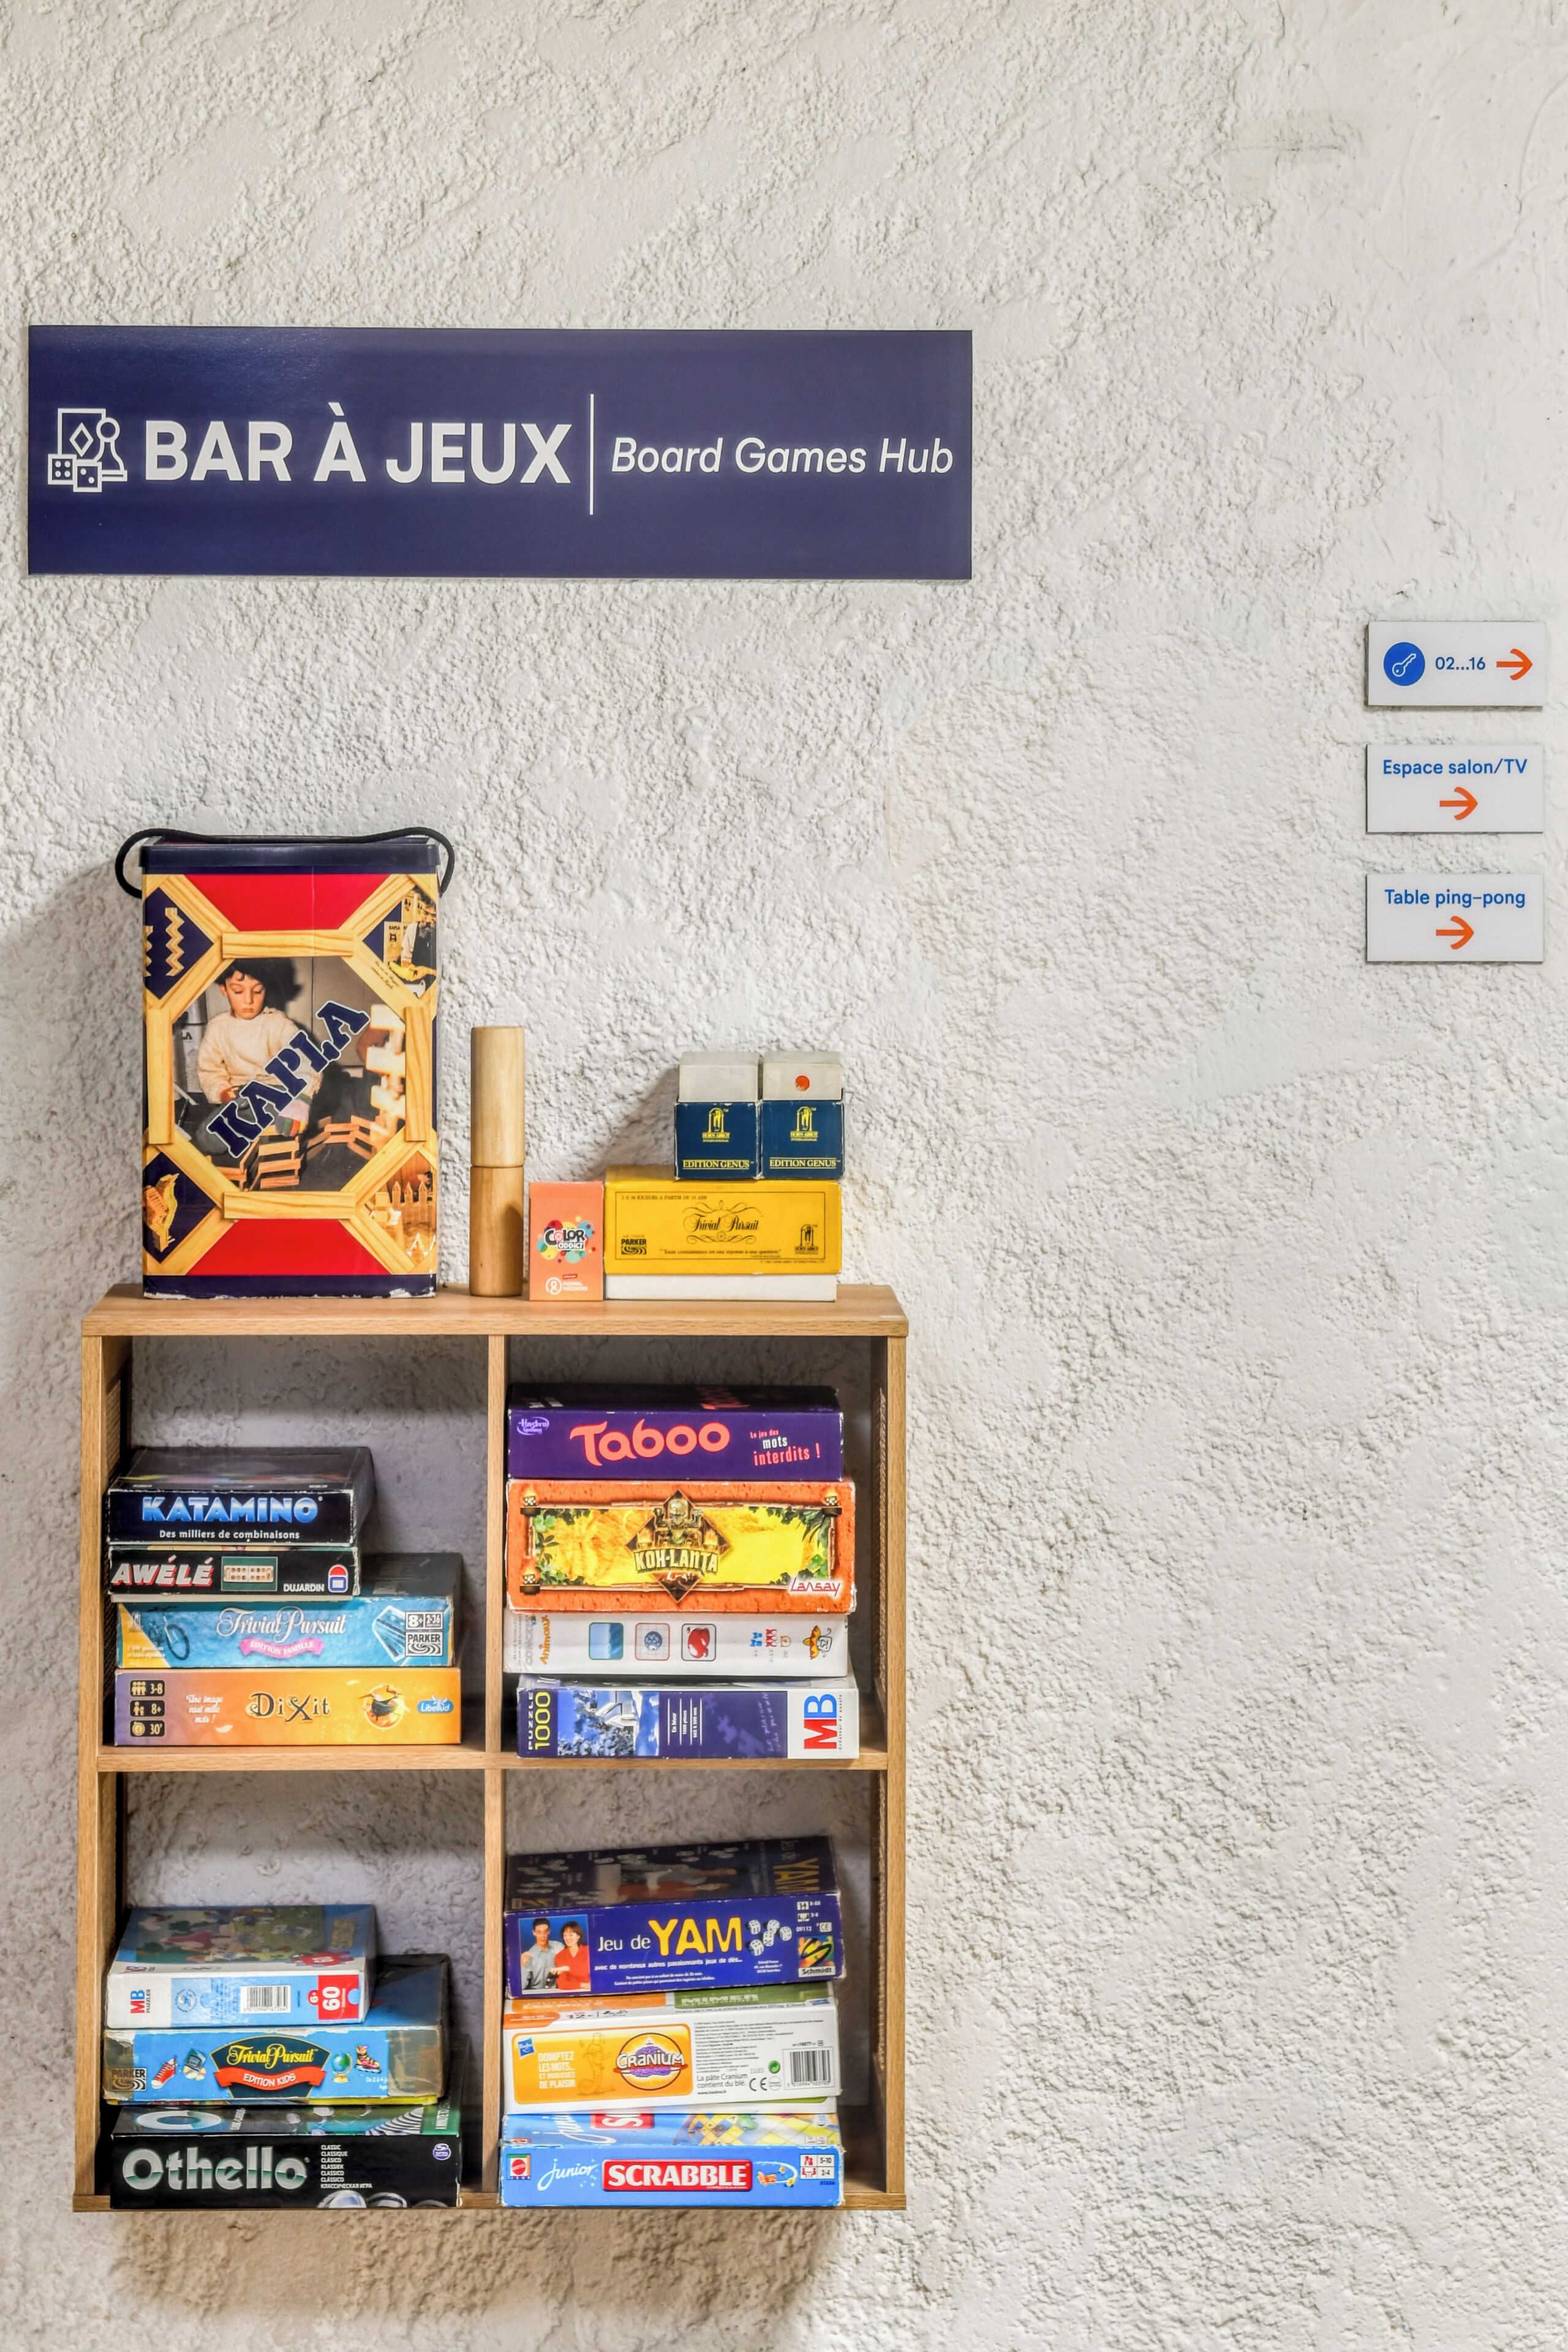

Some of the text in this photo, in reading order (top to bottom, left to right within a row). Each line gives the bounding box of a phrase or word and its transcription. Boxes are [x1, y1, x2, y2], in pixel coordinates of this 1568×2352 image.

[145, 401, 572, 484] BAR À JEUX
[611, 437, 954, 475] Board Games Hub
[1434, 656, 1487, 671] 02...16
[1382, 758, 1528, 780] Espace salon/TV
[1384, 889, 1526, 908] Table ping-pong
[205, 1000, 371, 1158] KAPLA
[690, 1213, 760, 1233] Trivial Pursuit
[569, 1418, 731, 1466] Taboo
[758, 1430, 767, 1439] jeu
[763, 1436, 788, 1450] mots
[753, 1446, 810, 1466] interdits
[142, 1496, 318, 1523] KATAMINO
[159, 1529, 300, 1540] Des milliers de combinaisons
[635, 1549, 718, 1573] KOH-LANTA
[110, 1555, 214, 1587] AWÉLÉ
[283, 1583, 325, 1593] DUJARDIN
[791, 1577, 841, 1597] Lansay
[216, 1605, 347, 1643] Trivial Pursuit
[408, 1614, 424, 1627] 8+
[284, 1640, 314, 1655] FAMILLE
[407, 1634, 441, 1643] PARKER
[150, 1683, 163, 1695] 3-8
[186, 1694, 224, 1706] Une image
[204, 1704, 221, 1714] mille
[420, 1700, 451, 1713] Libellud
[535, 1691, 551, 1751] 1000
[804, 1694, 837, 1750] MB
[597, 1917, 743, 1956] Jeu de YAM
[802, 1967, 832, 1975] Schmidt
[130, 1989, 145, 2013] MB
[309, 1991, 319, 2003] 6+
[322, 1986, 341, 2011] 60
[226, 2043, 314, 2070] Trivial Pursuit
[538, 2051, 575, 2062] DOMPTEZ
[111, 2068, 146, 2078] PARKER
[538, 2062, 550, 2073] LES
[243, 2072, 296, 2087] EDITION KIDS
[539, 2079, 576, 2089] DE PLAISIR
[122, 2146, 307, 2190] Othello
[608, 2164, 747, 2187] SCRABBLE
